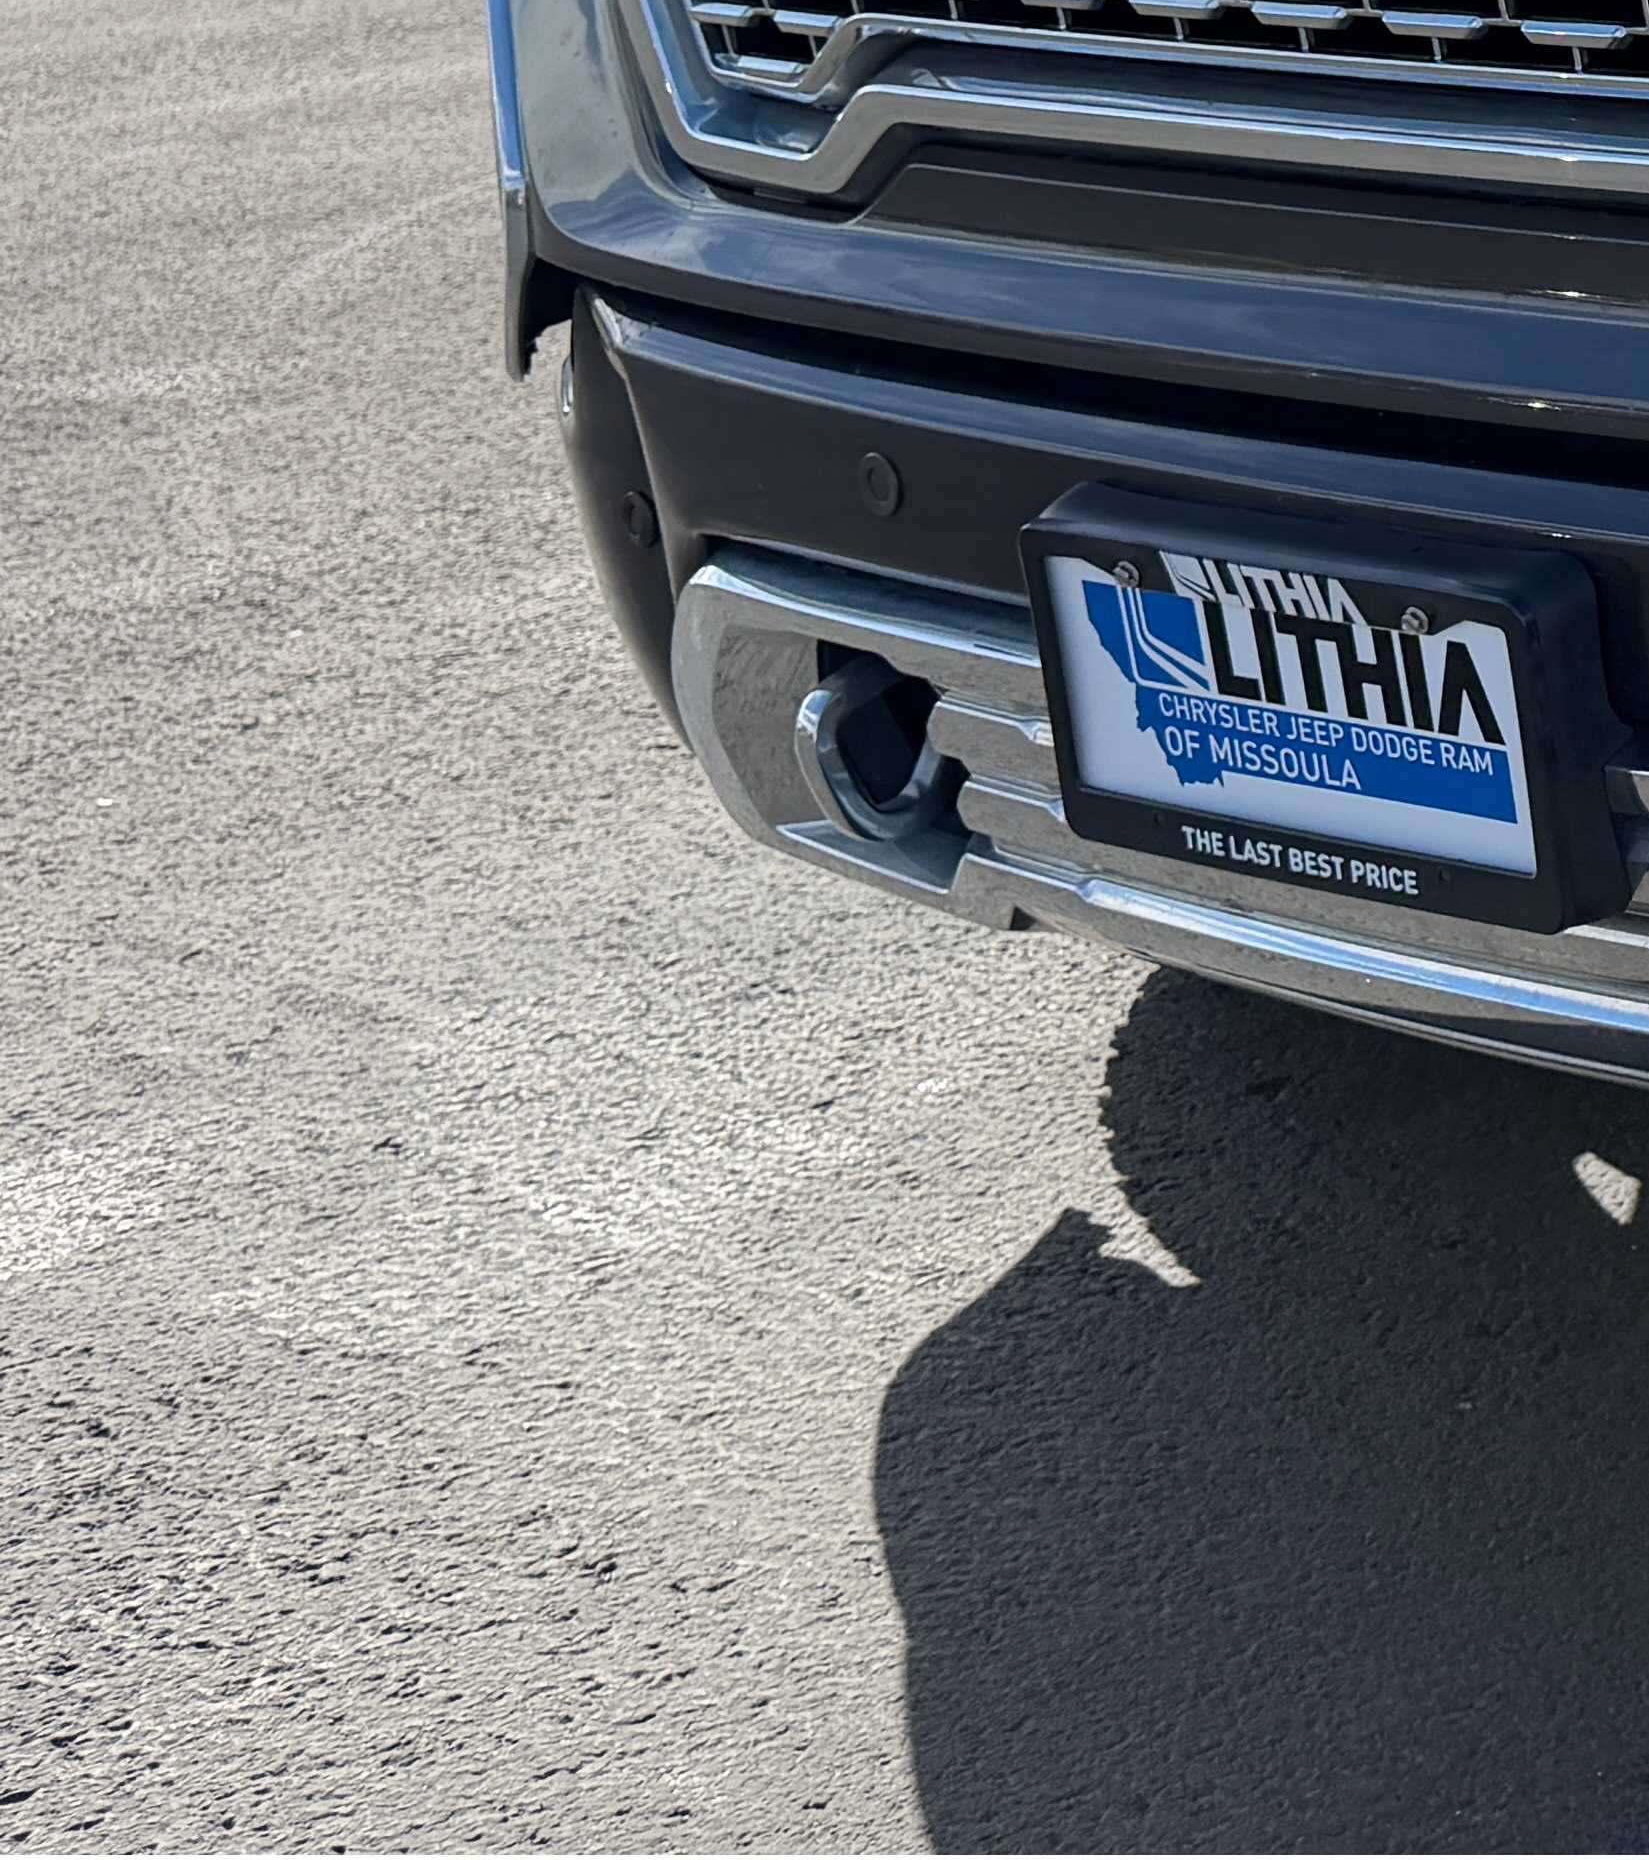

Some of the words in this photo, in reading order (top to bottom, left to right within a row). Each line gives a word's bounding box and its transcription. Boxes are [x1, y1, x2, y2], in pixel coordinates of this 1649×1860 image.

[1202, 558, 1371, 626] LITHIA
[1202, 598, 1507, 746] LITHIA
[1158, 692, 1281, 738] CHRYSLER
[1286, 717, 1345, 748] JEEP
[1351, 727, 1436, 766] DODGE
[1439, 741, 1495, 777] RAM
[1163, 725, 1201, 760] OF
[1208, 735, 1362, 791] MISSOULA
[1180, 825, 1226, 858] THE
[1227, 835, 1283, 869] LAST
[1287, 846, 1345, 881] BEST
[1350, 859, 1420, 896] PRICE
